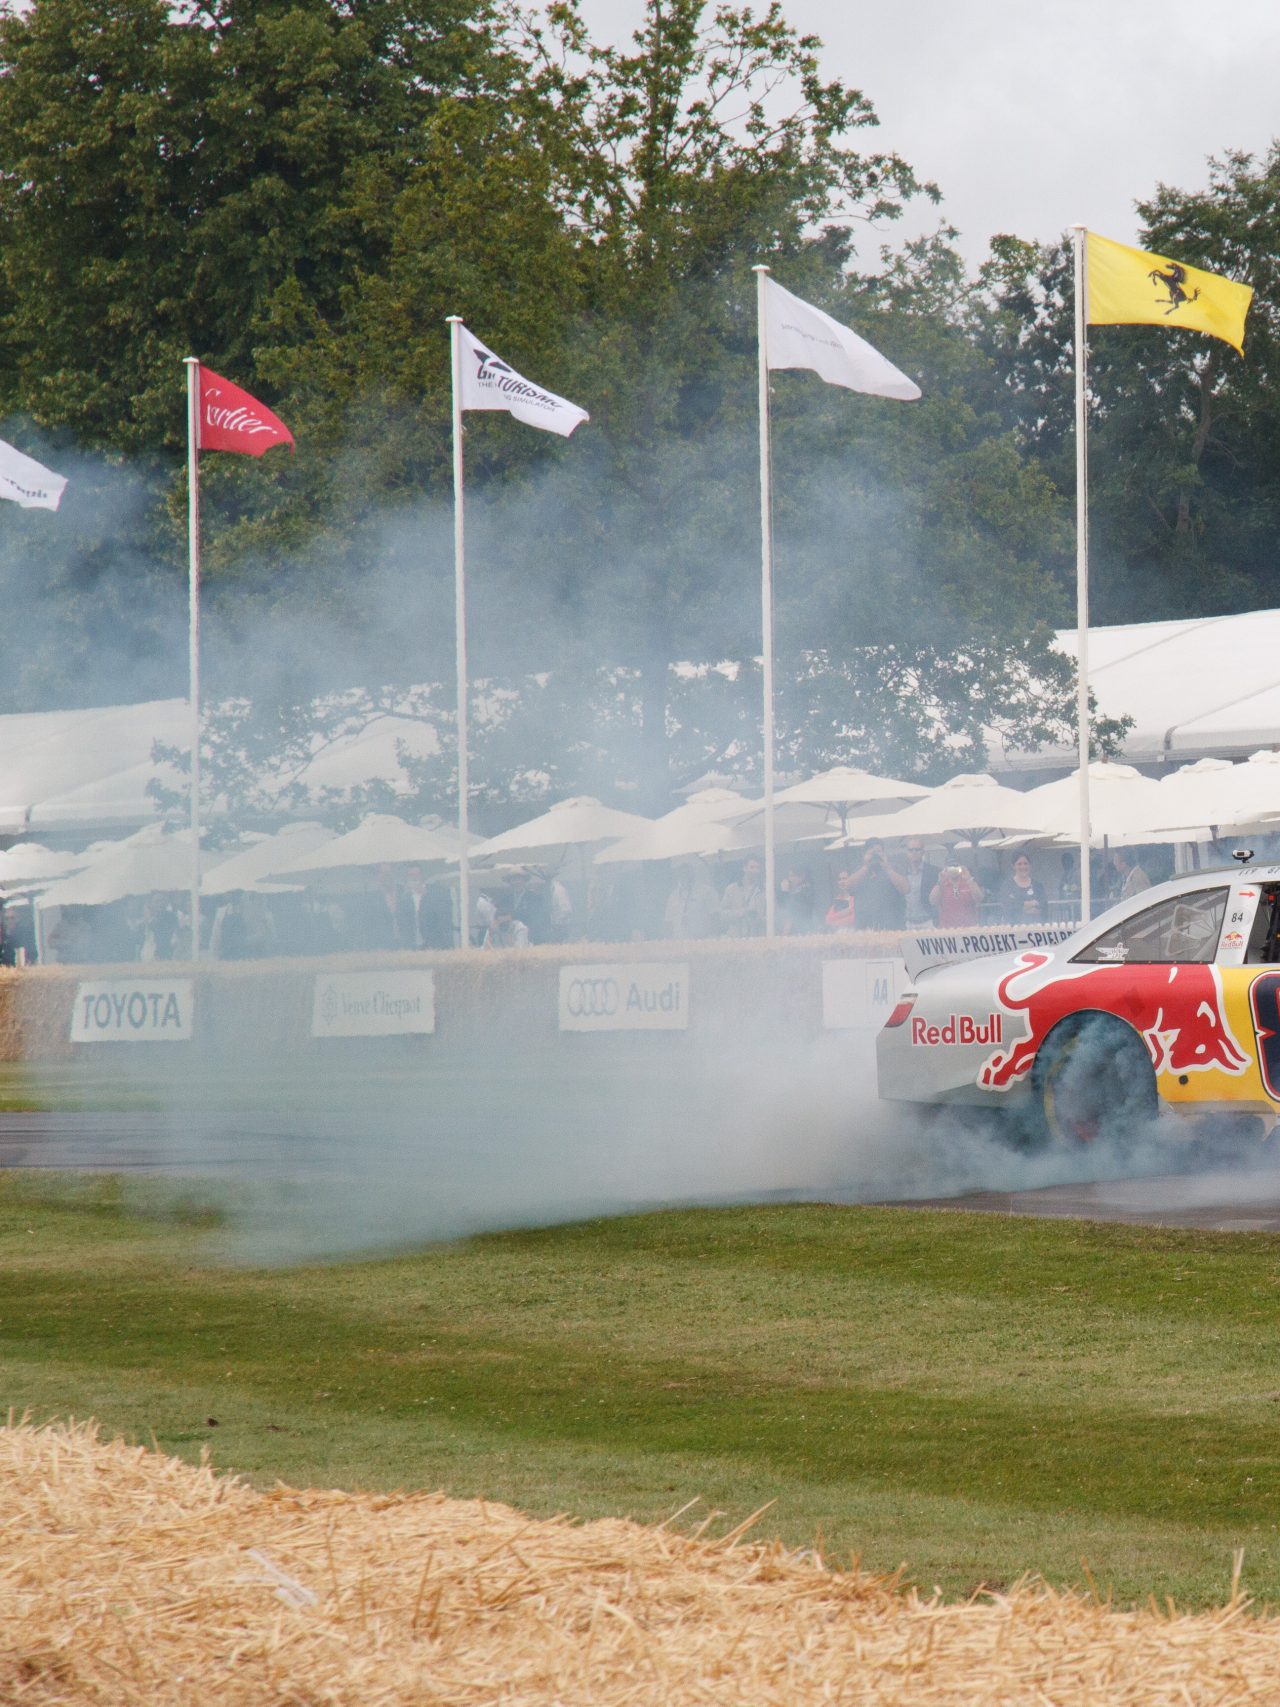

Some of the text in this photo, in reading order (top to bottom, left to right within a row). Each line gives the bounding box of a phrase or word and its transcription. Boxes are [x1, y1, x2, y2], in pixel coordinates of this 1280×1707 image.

[1231, 912, 1244, 922] 84
[83, 991, 182, 1029] TOYOTA
[626, 981, 680, 1011] Audi
[911, 1012, 1003, 1046] Red Bull
